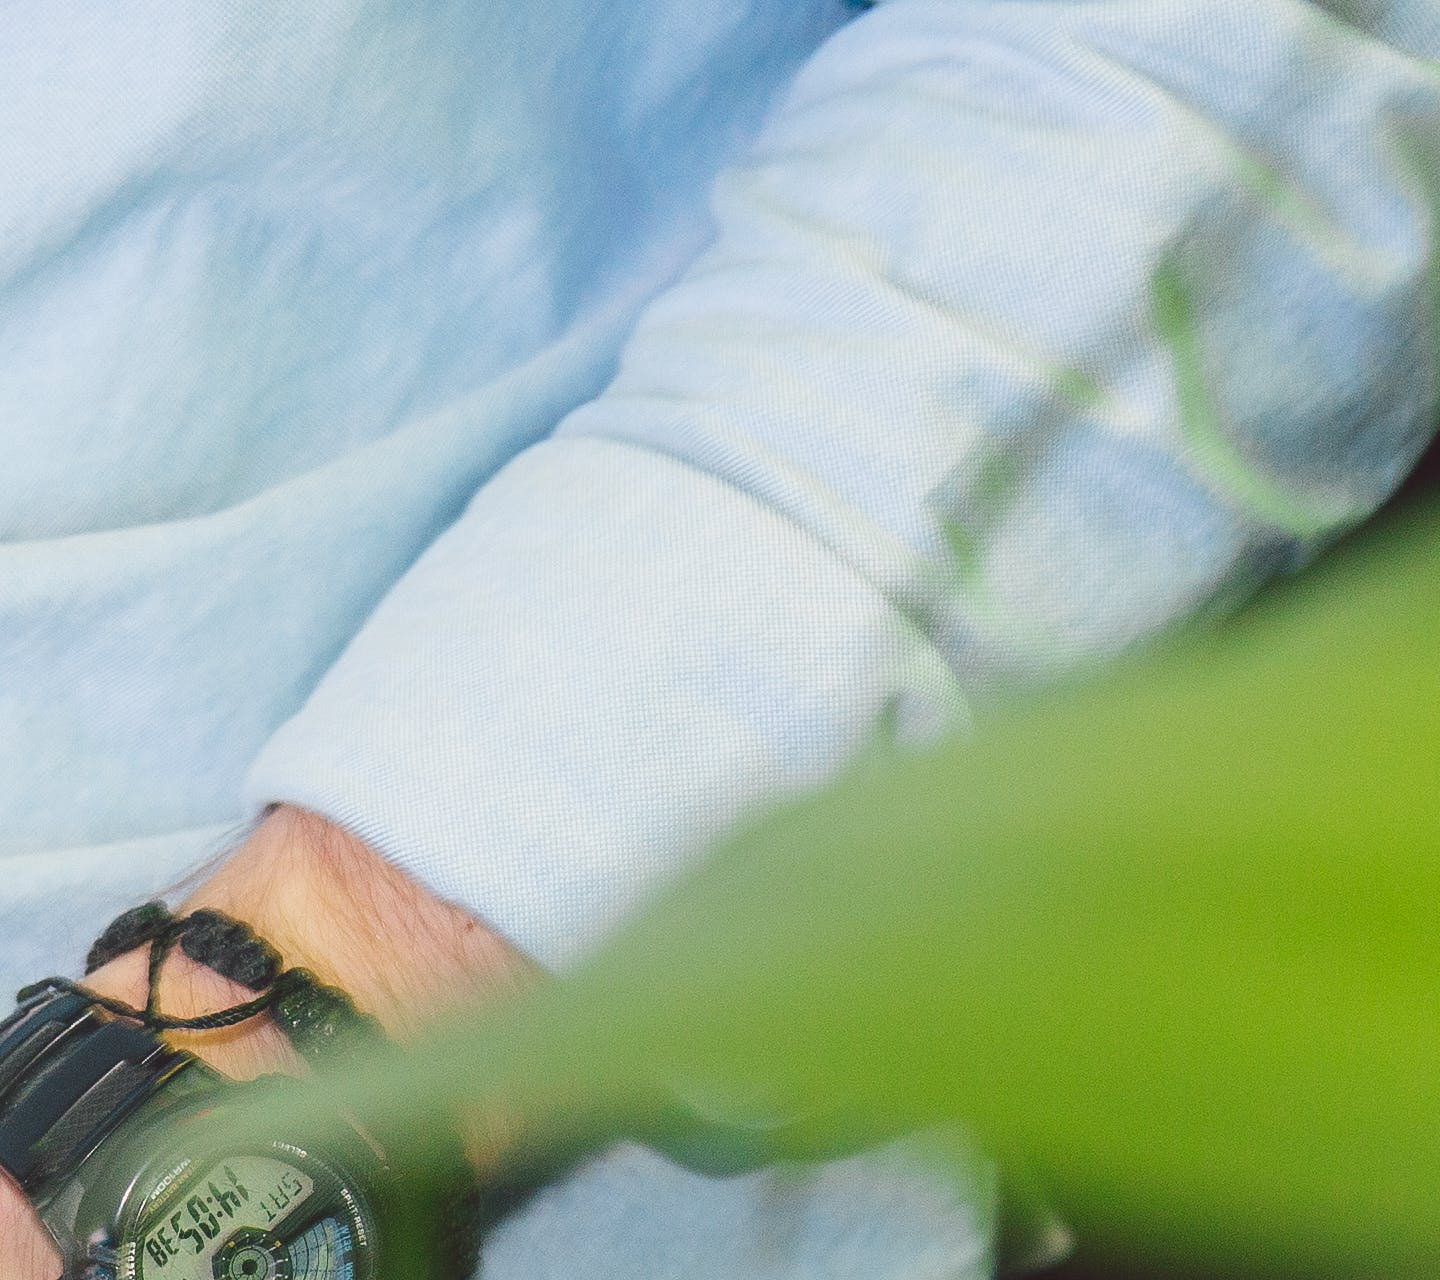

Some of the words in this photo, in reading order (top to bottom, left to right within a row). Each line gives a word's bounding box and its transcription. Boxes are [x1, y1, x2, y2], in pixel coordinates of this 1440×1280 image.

[147, 1157, 192, 1201] WR100M
[255, 1170, 305, 1224] SAT
[165, 1163, 253, 1256] 14:05
[142, 1225, 182, 1269] 38
